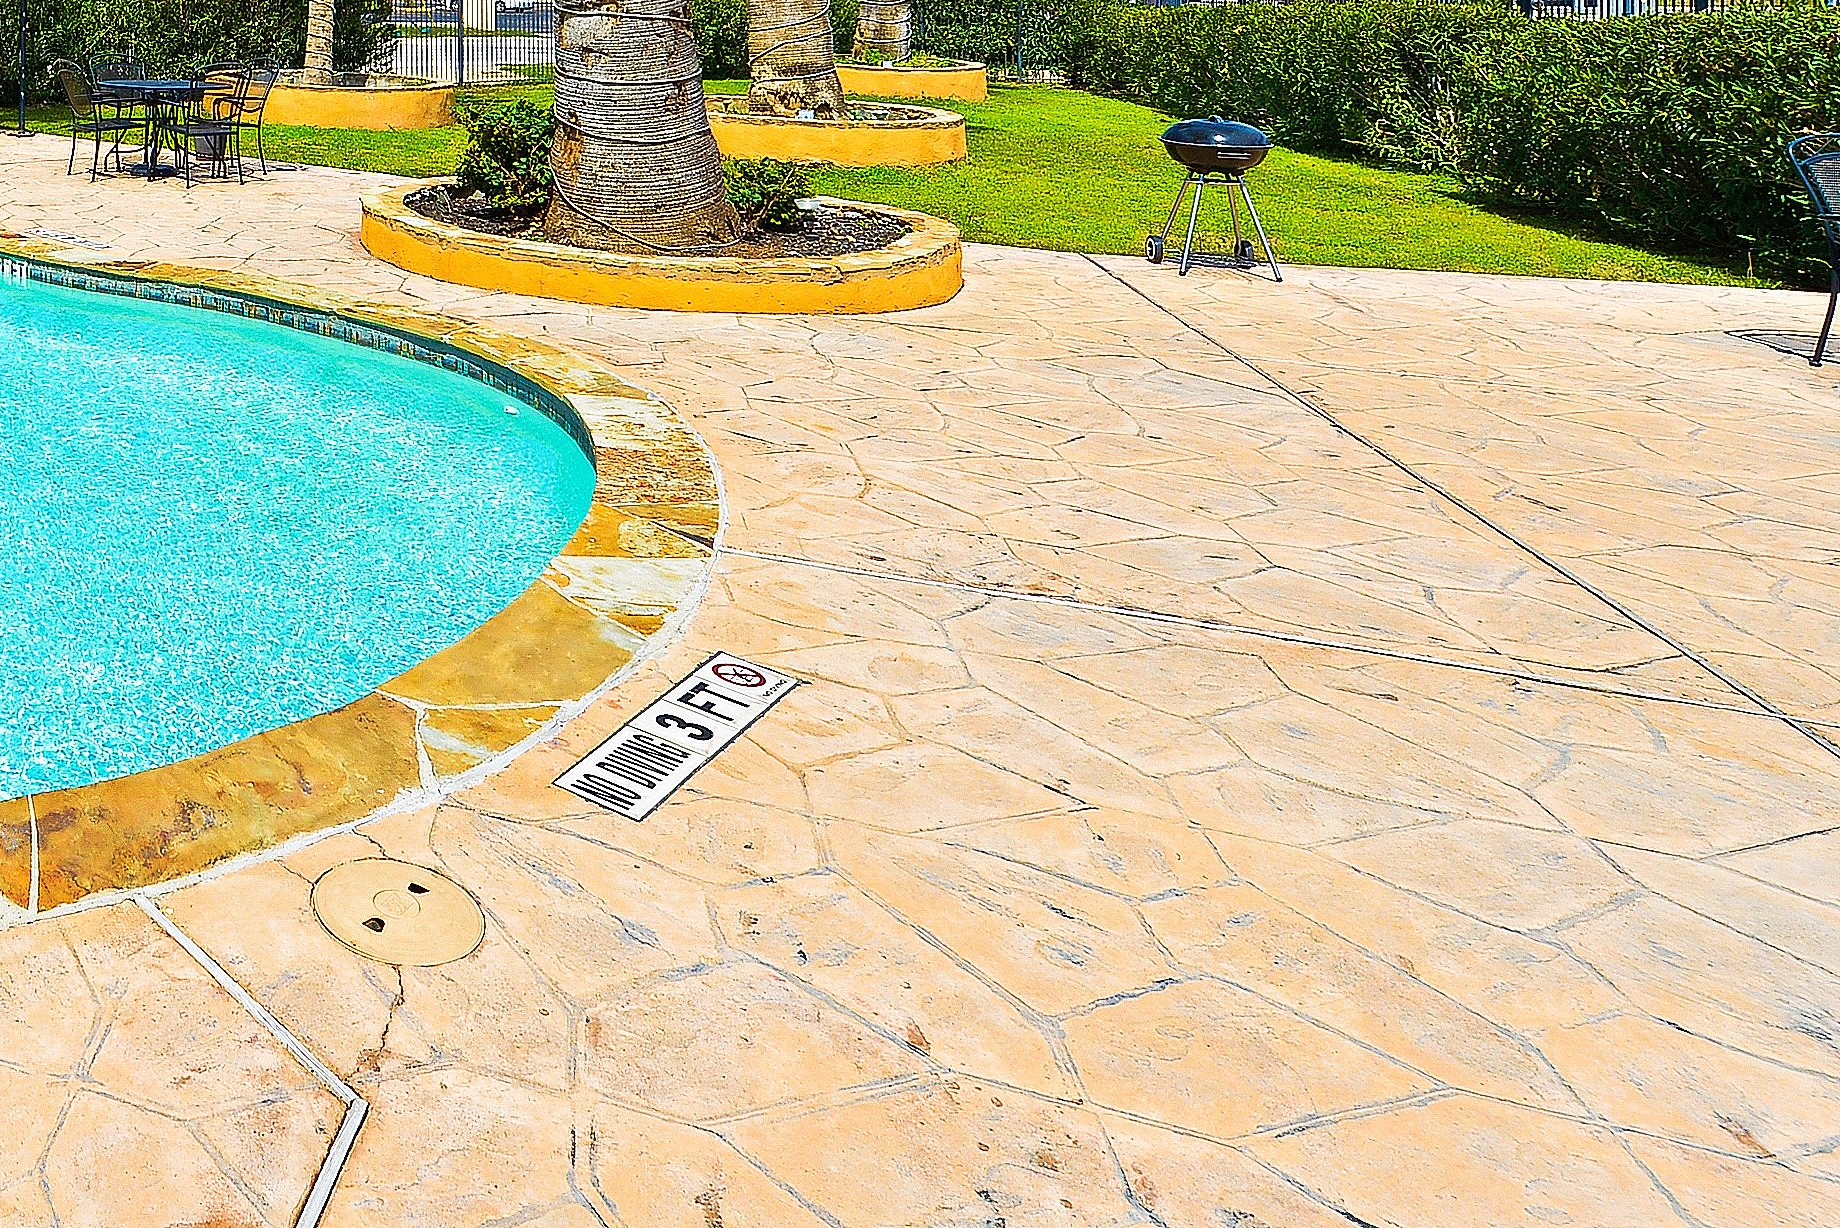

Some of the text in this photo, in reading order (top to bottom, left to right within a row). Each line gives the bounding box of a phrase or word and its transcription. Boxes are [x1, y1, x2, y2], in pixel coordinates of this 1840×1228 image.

[677, 682, 750, 721] FT
[655, 713, 714, 741] 3
[596, 734, 692, 789] DIVING
[570, 773, 641, 810] NO
